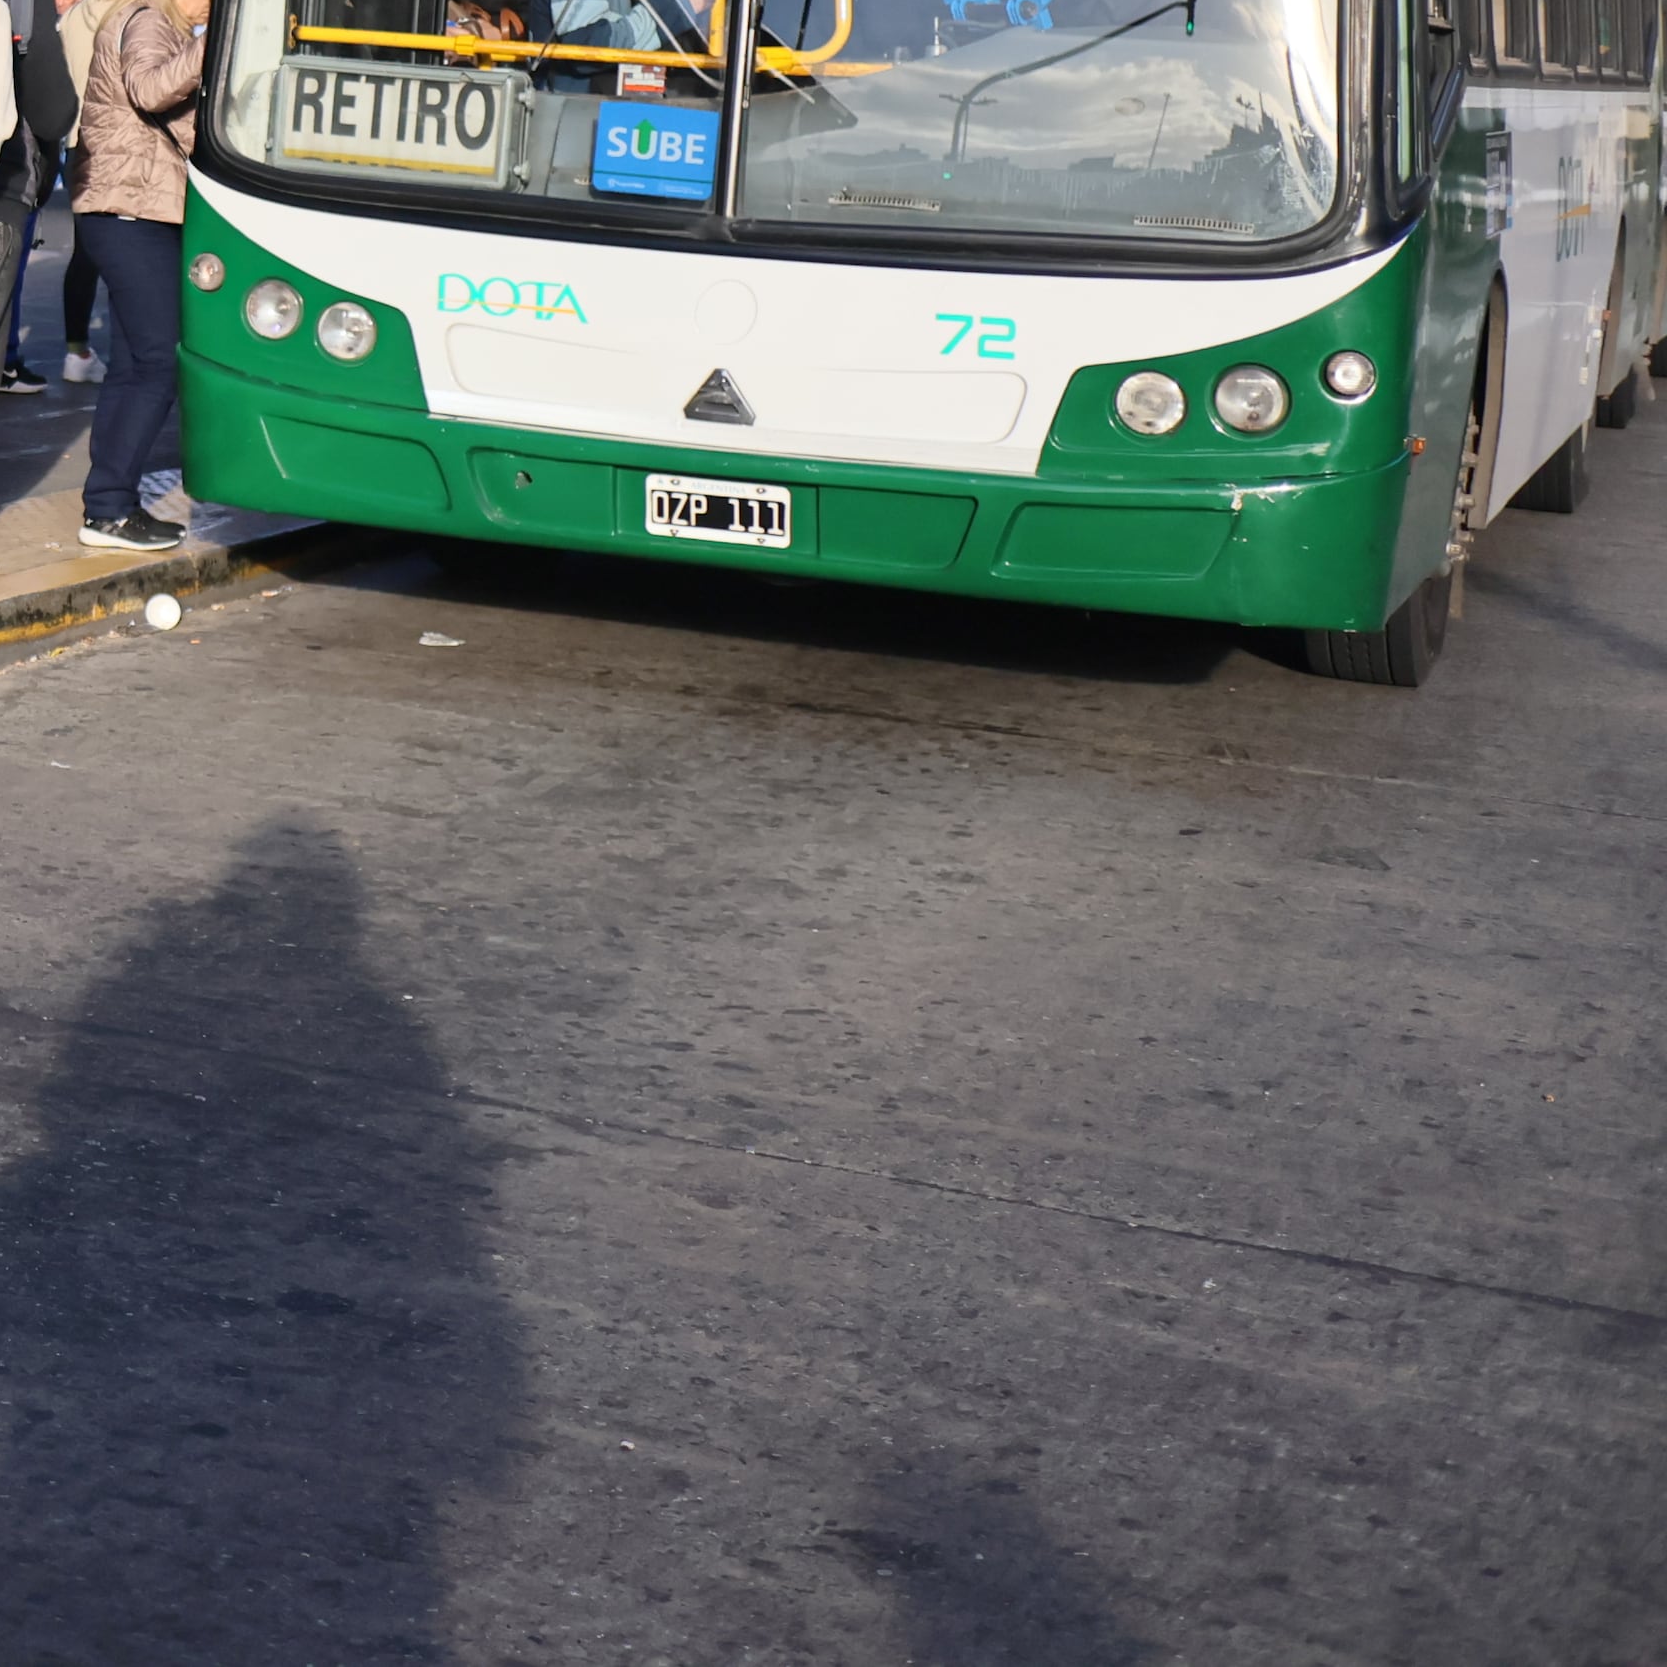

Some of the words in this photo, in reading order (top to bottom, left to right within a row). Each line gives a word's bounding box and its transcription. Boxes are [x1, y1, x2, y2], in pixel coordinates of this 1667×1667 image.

[292, 69, 496, 151] RETIRO
[606, 118, 707, 166] SUBE
[437, 273, 589, 324] DOTA
[935, 313, 1016, 360] 72
[652, 490, 708, 526] OZP
[728, 498, 784, 536] 111
